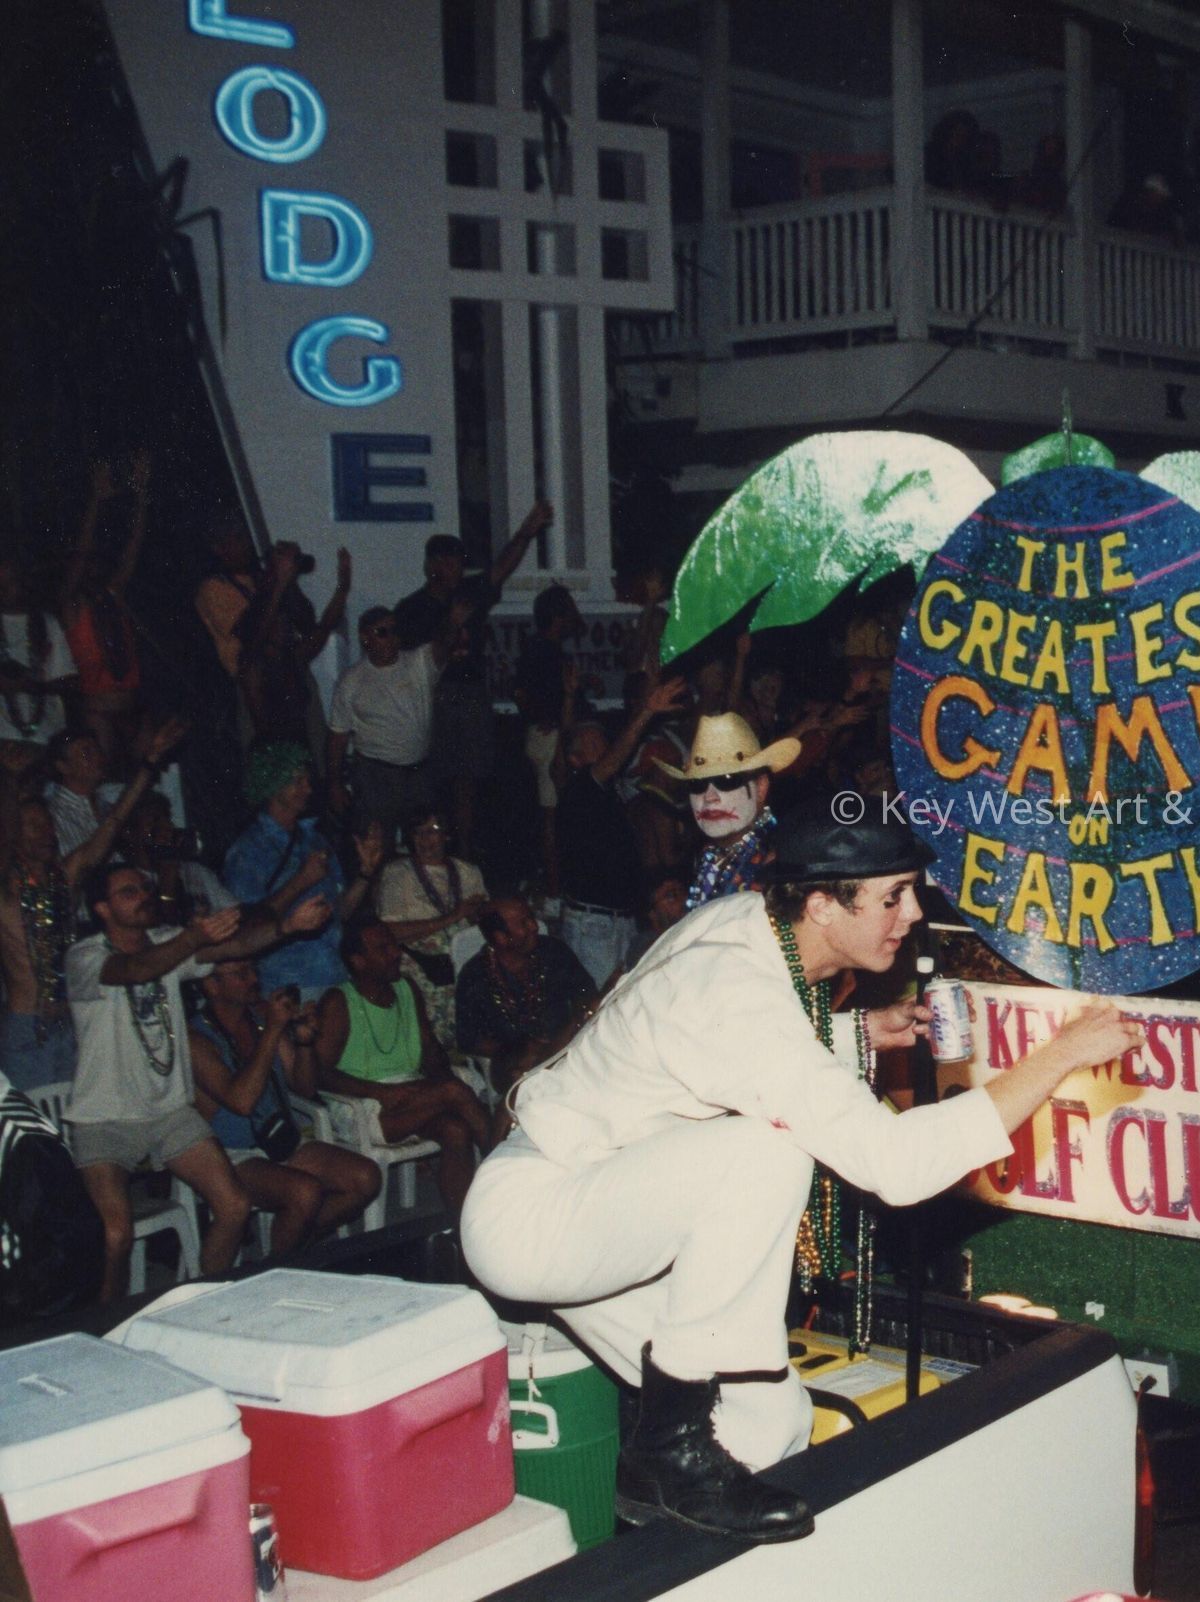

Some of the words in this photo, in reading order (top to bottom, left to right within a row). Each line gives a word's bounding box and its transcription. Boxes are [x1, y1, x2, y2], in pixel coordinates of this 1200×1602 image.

[1015, 532, 1136, 600] THE
[1067, 814, 1110, 847] ON
[964, 1096, 1091, 1204] LF
